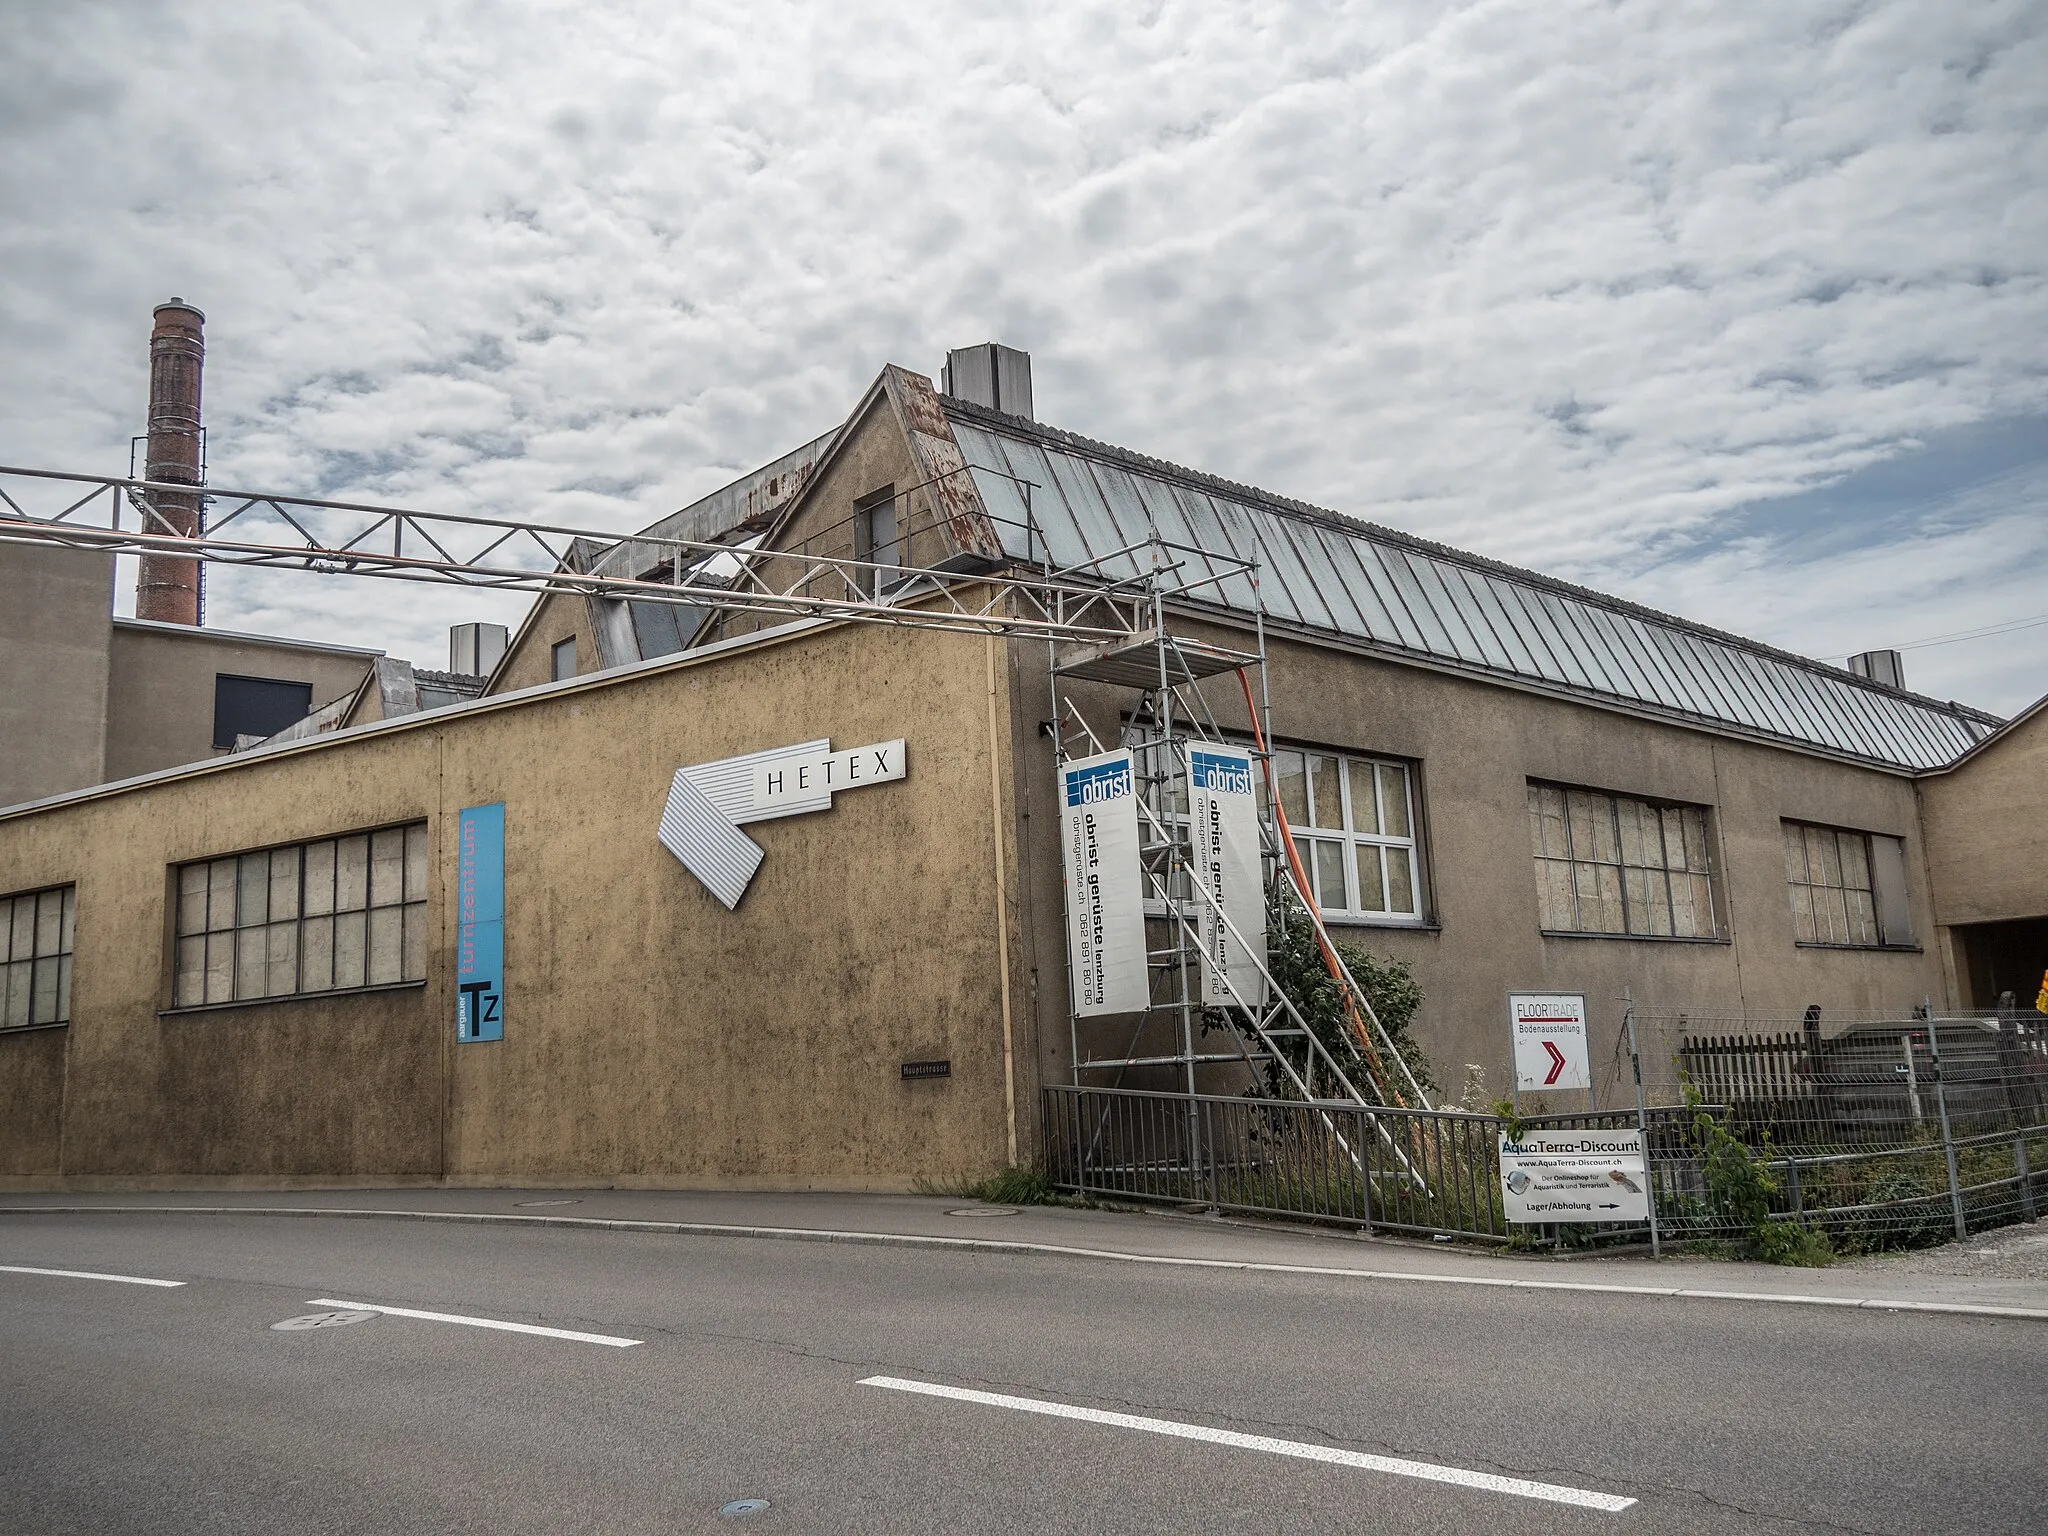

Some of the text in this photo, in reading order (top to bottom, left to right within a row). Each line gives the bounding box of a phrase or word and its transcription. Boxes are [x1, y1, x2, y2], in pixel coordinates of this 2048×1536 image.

[768, 750, 889, 794] HETEX
[1207, 762, 1252, 795] obrist
[1082, 770, 1131, 804] obrist
[1211, 799, 1223, 855] obrist
[461, 820, 476, 974] turnzentrum
[1086, 814, 1105, 1004] obrist gerüste lenzburg
[1080, 913, 1089, 937] 062
[1082, 941, 1091, 963] 891
[1083, 969, 1091, 986] 80
[1212, 978, 1219, 995] 80
[1085, 989, 1092, 1005] 80
[459, 996, 467, 1038] aargauer
[1517, 1004, 1579, 1017] FLOORTRADE
[1519, 1024, 1580, 1034] Bodenausstellung
[903, 1065, 947, 1075] Hauptstrasse
[1502, 1140, 1640, 1155] AquaTerra-Discount
[1516, 1159, 1622, 1168] www.AquaTerra-Discount.ch
[1533, 1183, 1565, 1191] Aquaristik
[1526, 1202, 1591, 1212] Lager/Abholung
